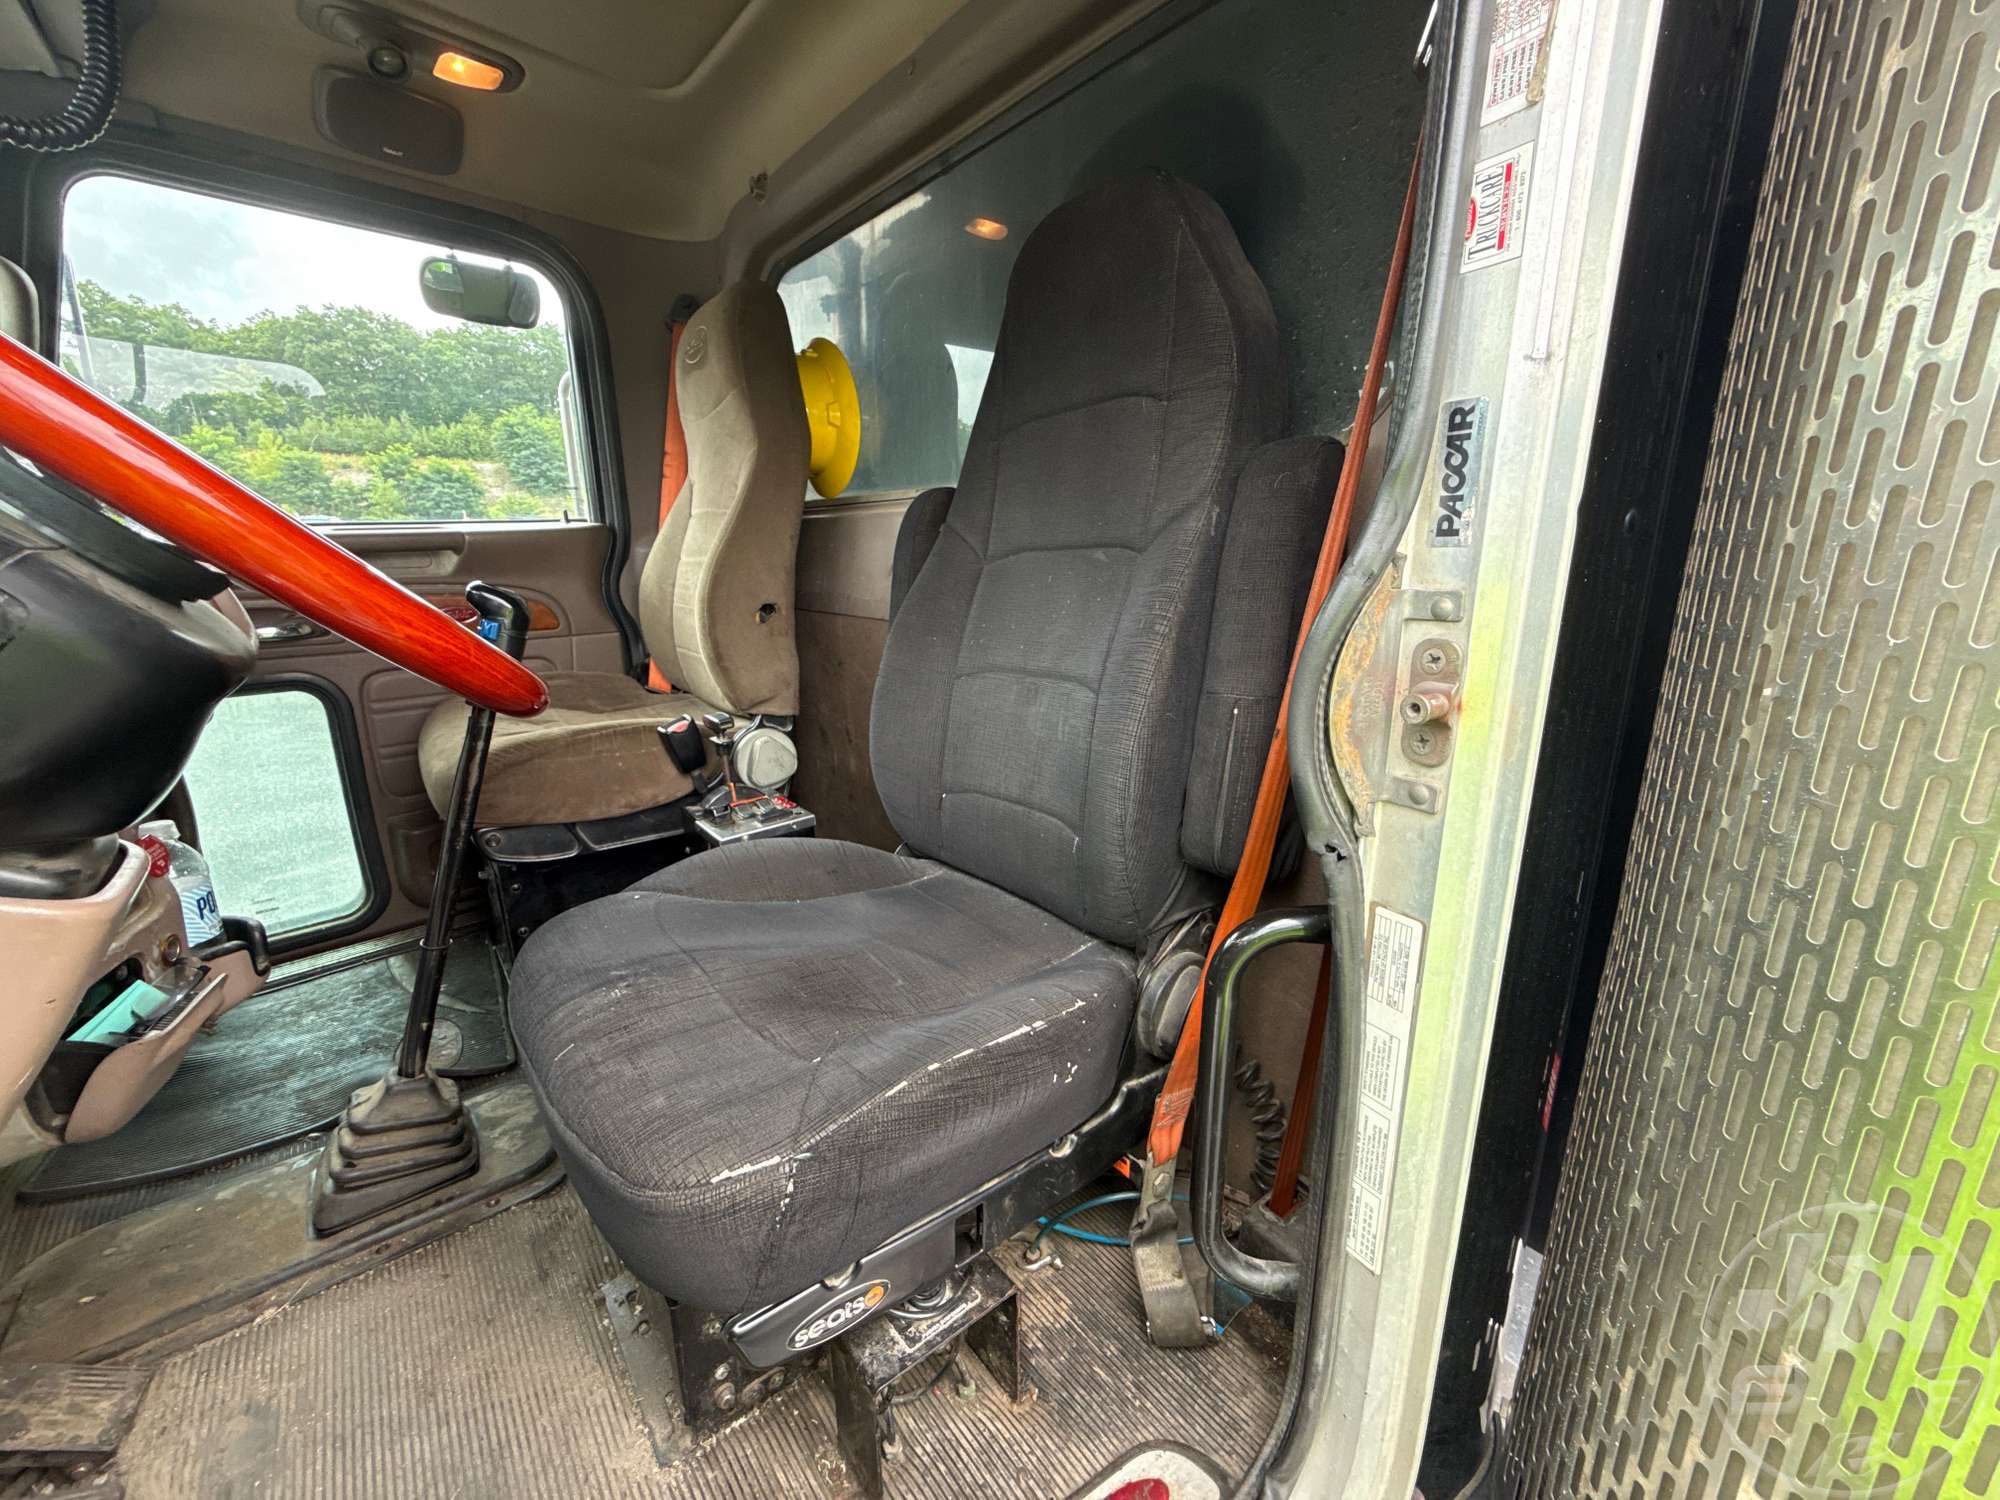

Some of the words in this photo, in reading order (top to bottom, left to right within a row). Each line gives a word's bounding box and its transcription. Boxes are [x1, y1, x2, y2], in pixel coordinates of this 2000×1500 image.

[1468, 165, 1504, 260] TRUCKCARE
[1435, 404, 1476, 537] PACCAR
[795, 1297, 865, 1348] seats
